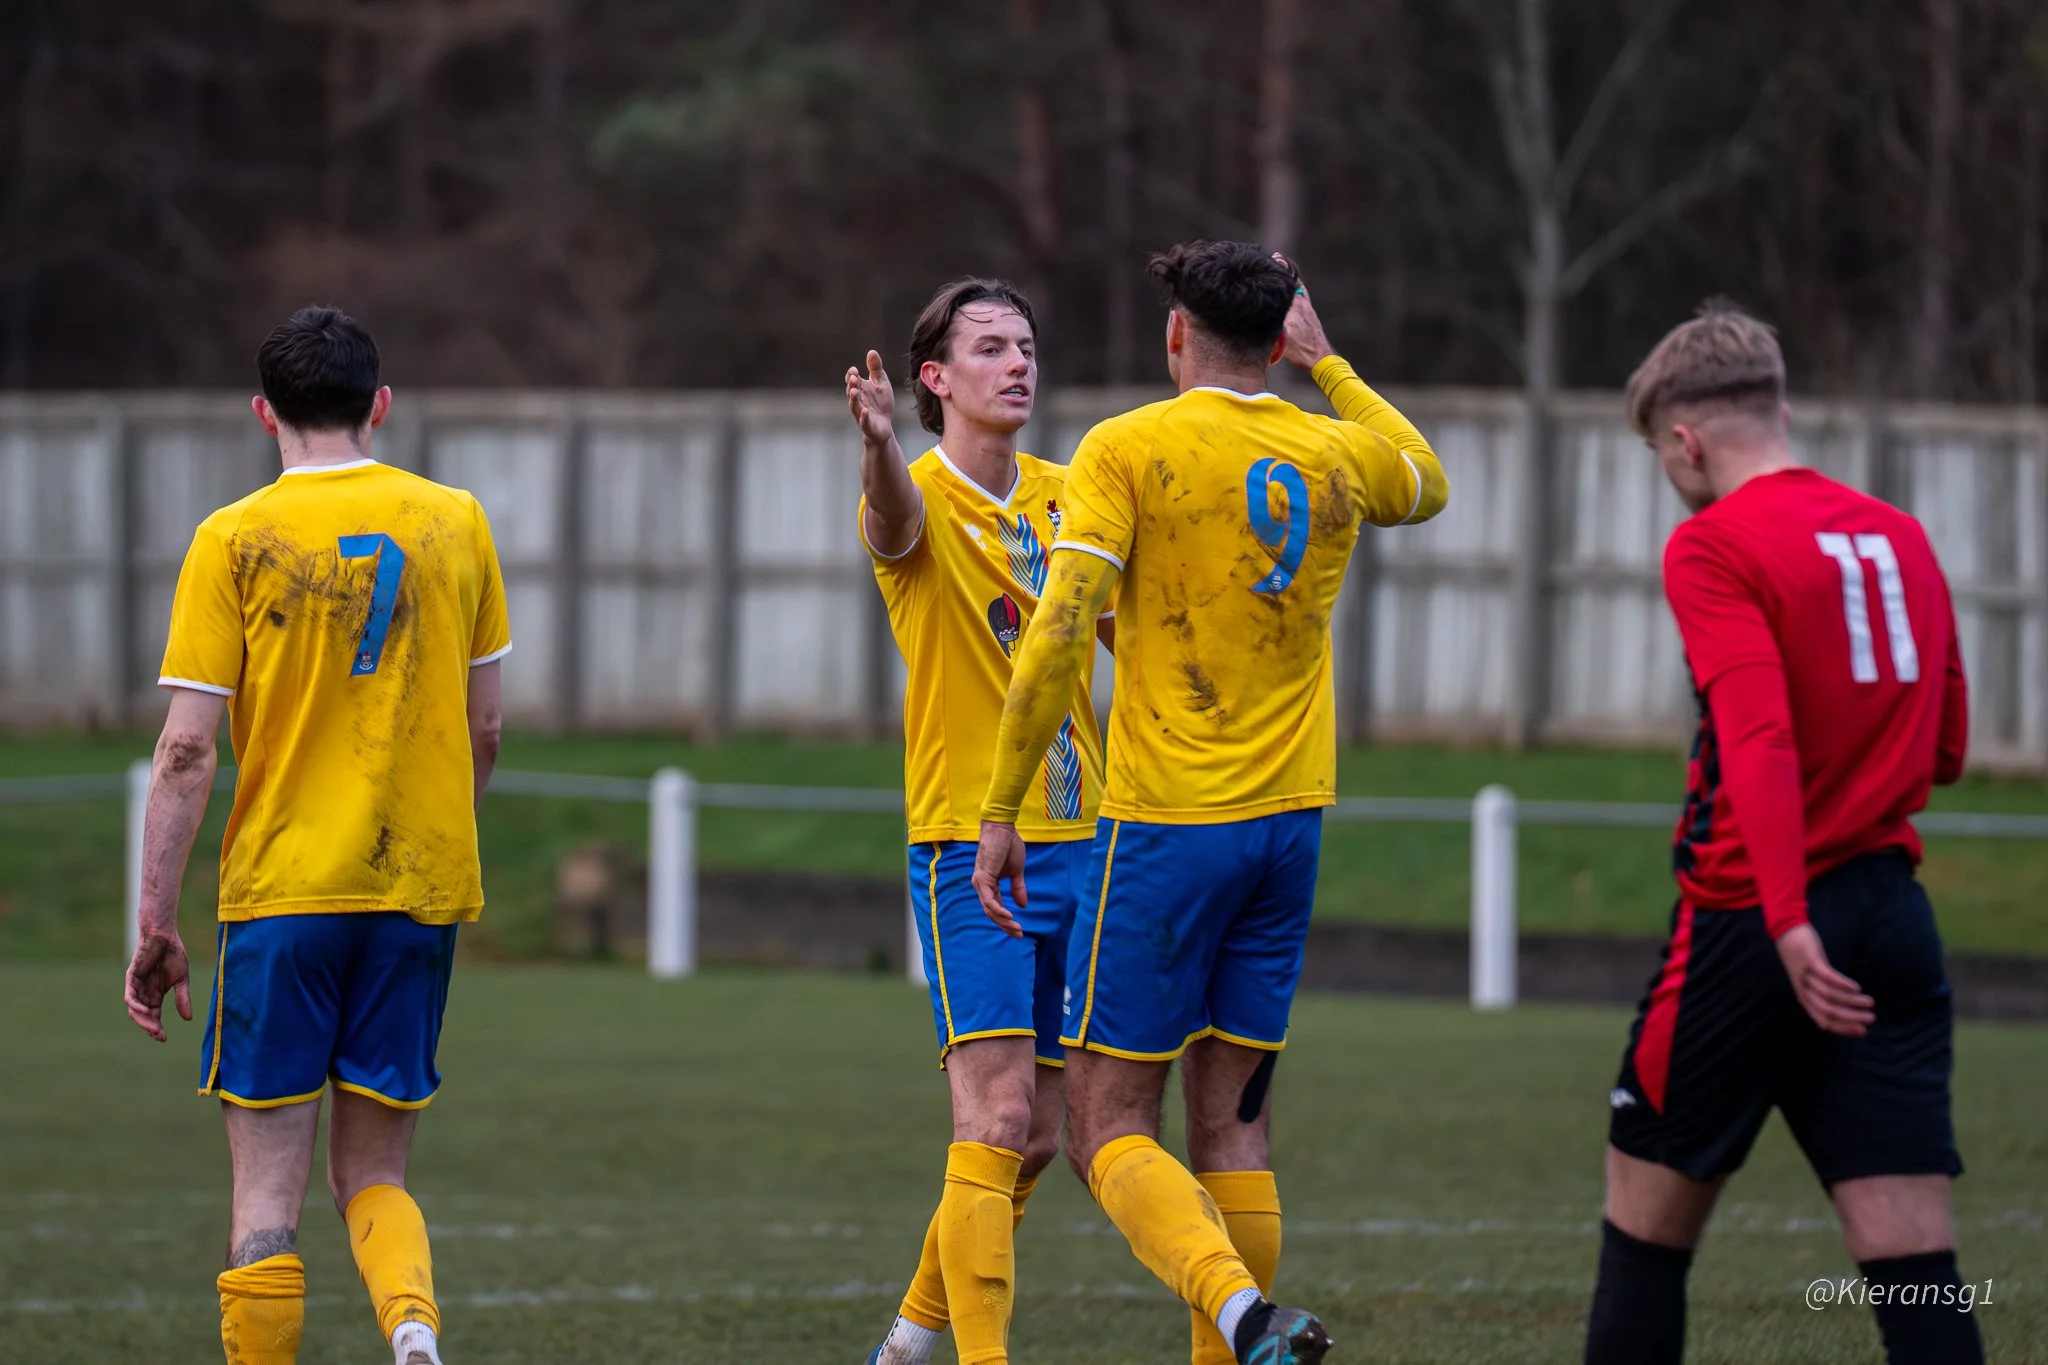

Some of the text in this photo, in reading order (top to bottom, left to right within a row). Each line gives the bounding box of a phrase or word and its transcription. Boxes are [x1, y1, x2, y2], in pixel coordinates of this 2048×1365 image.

[1246, 457, 1311, 595] 9
[338, 532, 406, 676] 7
[1814, 531, 1919, 683] 11
